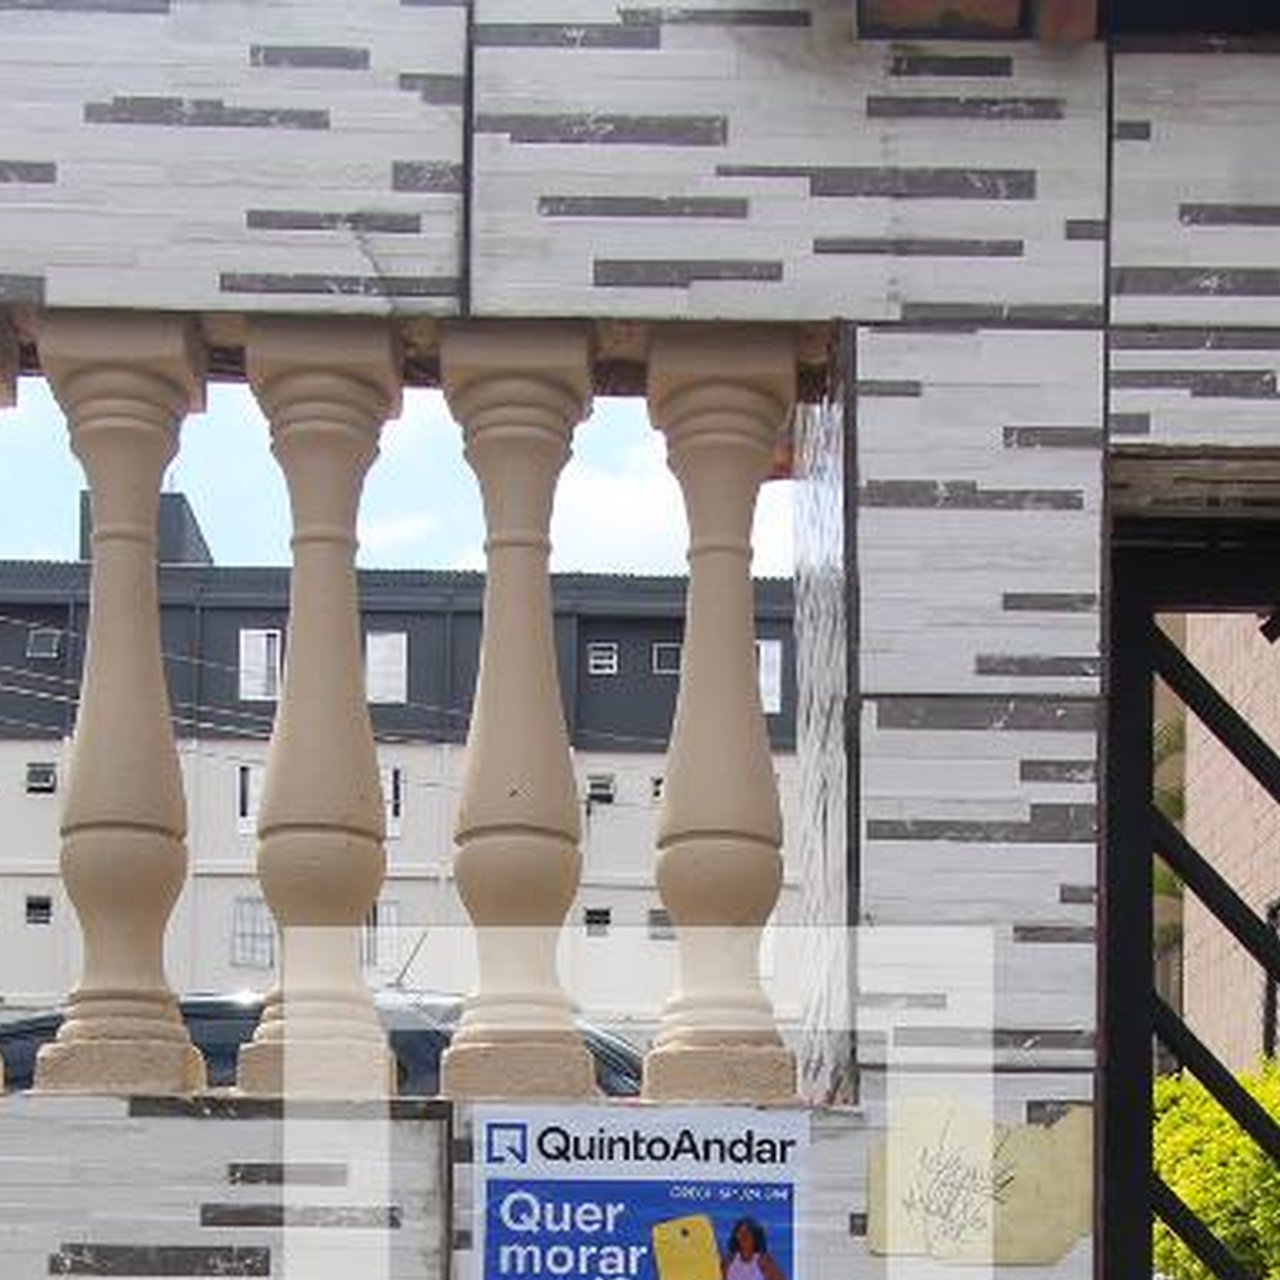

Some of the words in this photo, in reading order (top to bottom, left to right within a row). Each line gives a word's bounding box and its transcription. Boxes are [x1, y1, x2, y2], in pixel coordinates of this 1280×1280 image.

[537, 1127, 796, 1163] QuintoAndar
[500, 1191, 624, 1232] Quer
[499, 1243, 647, 1275] morar
